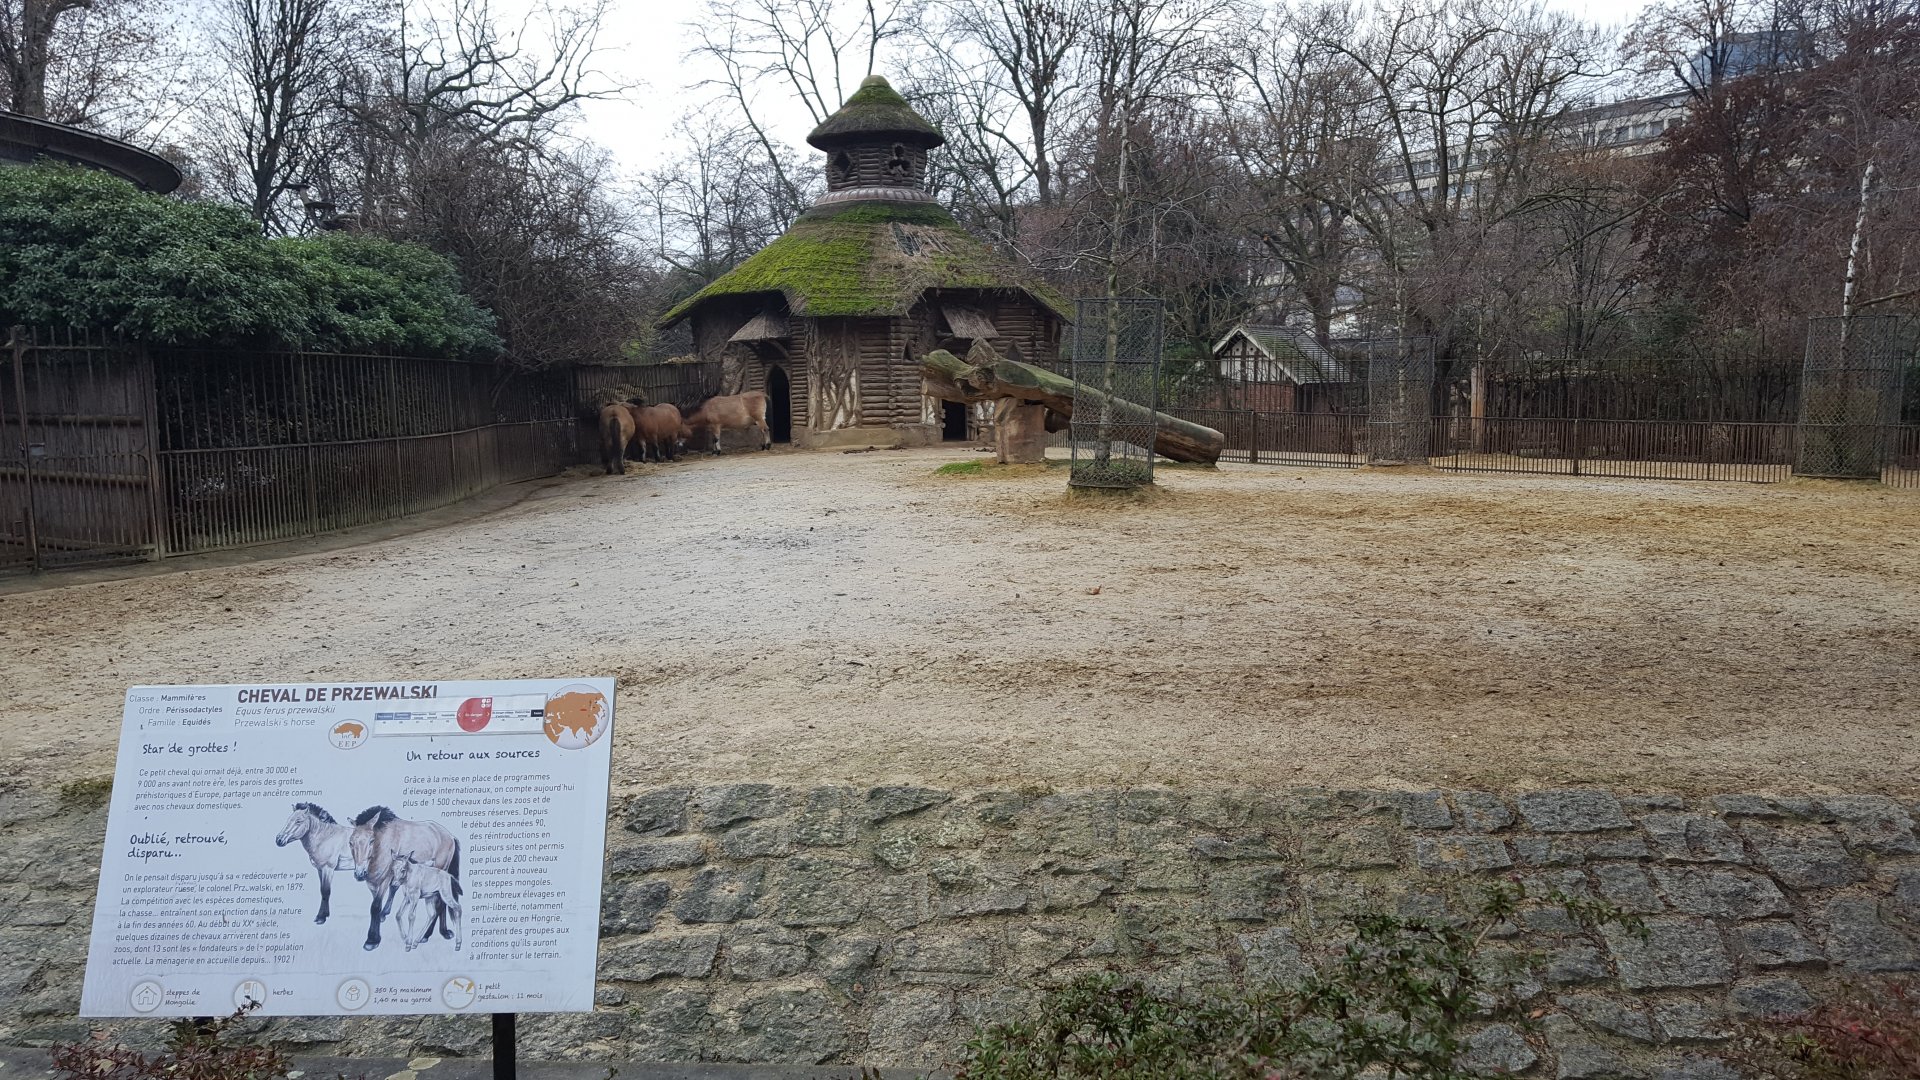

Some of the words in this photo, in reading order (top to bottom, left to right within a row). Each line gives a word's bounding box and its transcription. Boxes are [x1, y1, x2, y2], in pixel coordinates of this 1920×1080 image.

[130, 695, 154, 703] Classe
[238, 688, 300, 703] CHEVAL
[305, 688, 327, 702] DE
[331, 685, 438, 700] PRZEWALSKI
[166, 706, 223, 715] Périssodactyles
[236, 707, 262, 717] Equus
[264, 706, 286, 715] ferus
[287, 705, 336, 716] przewalskii
[148, 719, 176, 727] Famille
[234, 718, 288, 727] Przewalski's
[291, 718, 316, 726] horse
[143, 744, 164, 754] Star
[168, 743, 184, 754] de
[188, 742, 229, 757] grottes
[407, 751, 422, 762] Un
[427, 750, 464, 761] retour
[469, 752, 490, 760] aux
[496, 750, 540, 759] sources
[150, 769, 166, 778] petit
[168, 768, 190, 776] cheval
[192, 768, 203, 777] qui
[204, 768, 225, 776] ornait
[172, 780, 191, 788] avant
[228, 779, 239, 787] les
[240, 778, 262, 788] parois
[264, 778, 277, 786] des
[278, 778, 304, 788] grottes
[404, 776, 425, 784] Grâce
[442, 775, 460, 783] mise
[472, 774, 492, 784] place
[504, 774, 551, 783] programmes
[136, 791, 187, 801] préhistoriques
[223, 791, 251, 800] partage
[263, 789, 290, 797] ancêtre
[403, 787, 437, 796] d'élevage
[506, 785, 532, 794] compte
[534, 784, 575, 794] aujourd'hui
[403, 799, 418, 808] plus
[452, 798, 481, 806] chevaux
[482, 797, 500, 805] dans
[502, 797, 513, 805] les
[441, 810, 486, 818] nombreuses
[523, 807, 548, 817] Depuis
[470, 820, 491, 829] début
[507, 818, 534, 828] années
[470, 832, 483, 840] des
[484, 831, 540, 840] réintroductions
[470, 844, 504, 854] plusieurs
[506, 843, 524, 851] sites
[525, 843, 537, 851] ont
[538, 842, 565, 852] permis
[485, 856, 501, 866] plus
[528, 854, 558, 862] chevaux
[144, 873, 169, 883] pensait
[170, 873, 196, 882] disparu
[242, 872, 288, 880] redécouverte
[469, 867, 509, 878] parcourent
[133, 885, 174, 895] explorateur
[206, 884, 232, 892] colonel
[472, 880, 483, 888] les
[485, 880, 513, 889] steppes
[484, 891, 521, 899] nombreux
[523, 890, 555, 900] élevages
[131, 896, 174, 906] compétition
[193, 896, 204, 905] les
[205, 896, 235, 906] espèces
[521, 902, 563, 910] notamment
[160, 908, 198, 917] entraînent
[250, 908, 267, 916] dans
[278, 908, 302, 916] nature
[132, 921, 142, 929] fin
[142, 921, 156, 929] des
[158, 920, 184, 929] années
[482, 915, 507, 924] Lozère
[116, 933, 149, 943] quelques
[150, 933, 180, 941] dizaines
[192, 932, 222, 940] chevaux
[260, 931, 278, 940] dans
[280, 931, 291, 939] les
[472, 927, 508, 938] préparent
[510, 927, 523, 935] des
[525, 928, 555, 937] groupes
[134, 945, 151, 953] dont
[162, 945, 178, 953] sont
[180, 944, 191, 953] les
[199, 944, 238, 952] fondateurs
[265, 943, 304, 953] population
[471, 939, 509, 948] conditions
[533, 939, 557, 947] auront
[156, 957, 195, 967] ménagerie
[207, 955, 240, 965] accueille
[476, 952, 509, 960] affronter
[485, 982, 500, 993] petit
[166, 990, 189, 998] steppes
